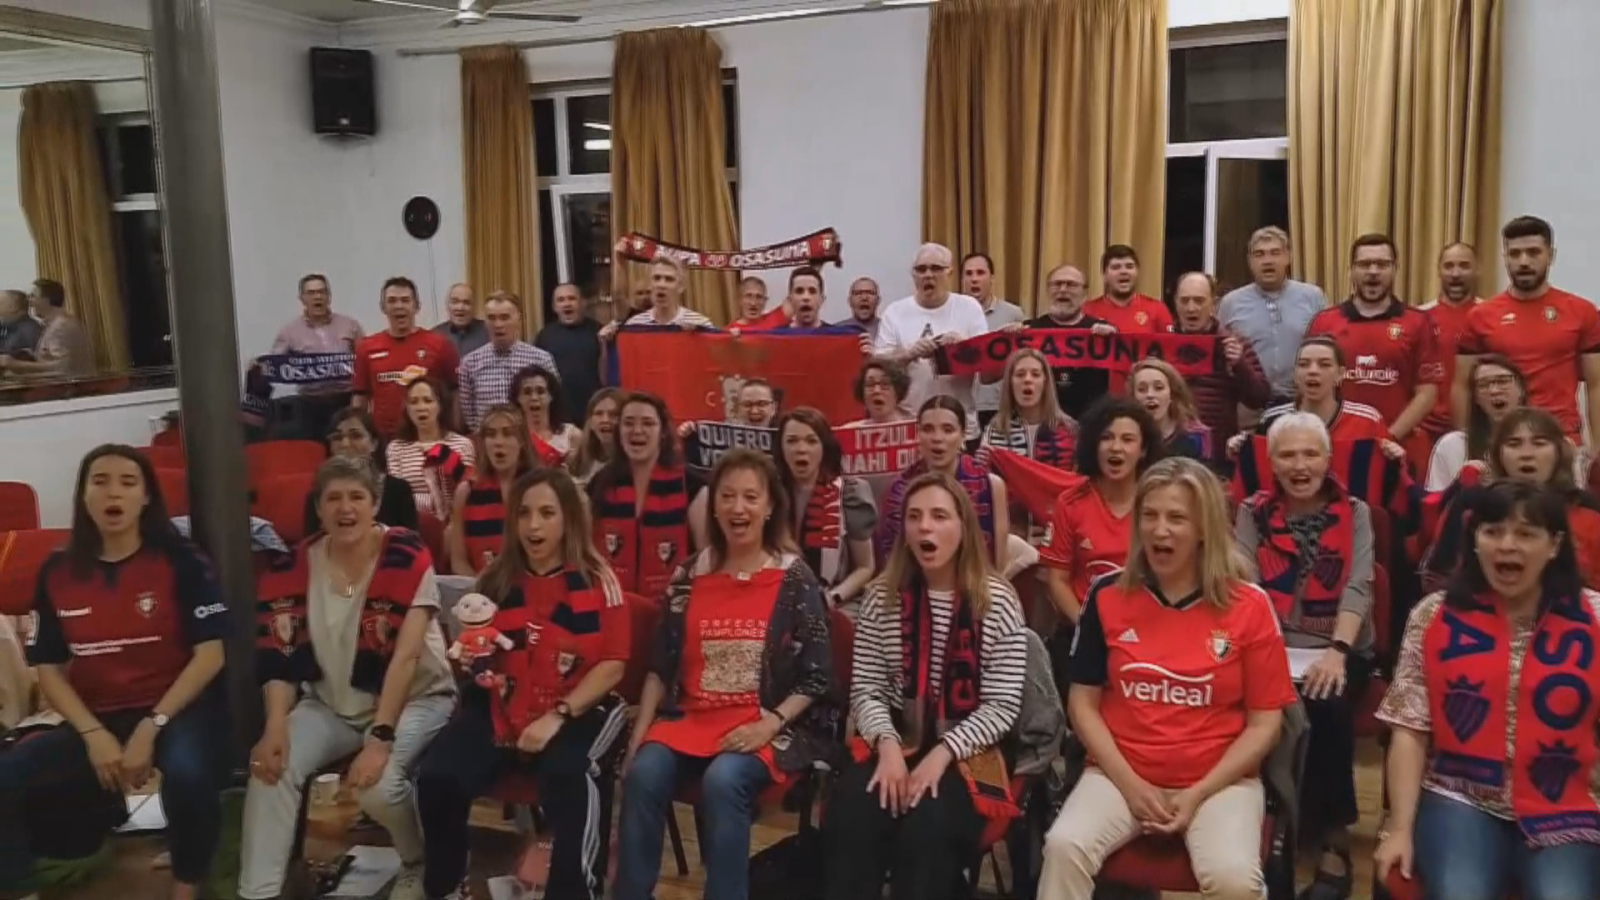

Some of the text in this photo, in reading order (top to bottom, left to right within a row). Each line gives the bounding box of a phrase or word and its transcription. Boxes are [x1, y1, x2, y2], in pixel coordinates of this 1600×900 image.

[729, 240, 809, 268] OSASUNA
[699, 424, 771, 451] QUIERO
[1120, 679, 1213, 706] verleal
